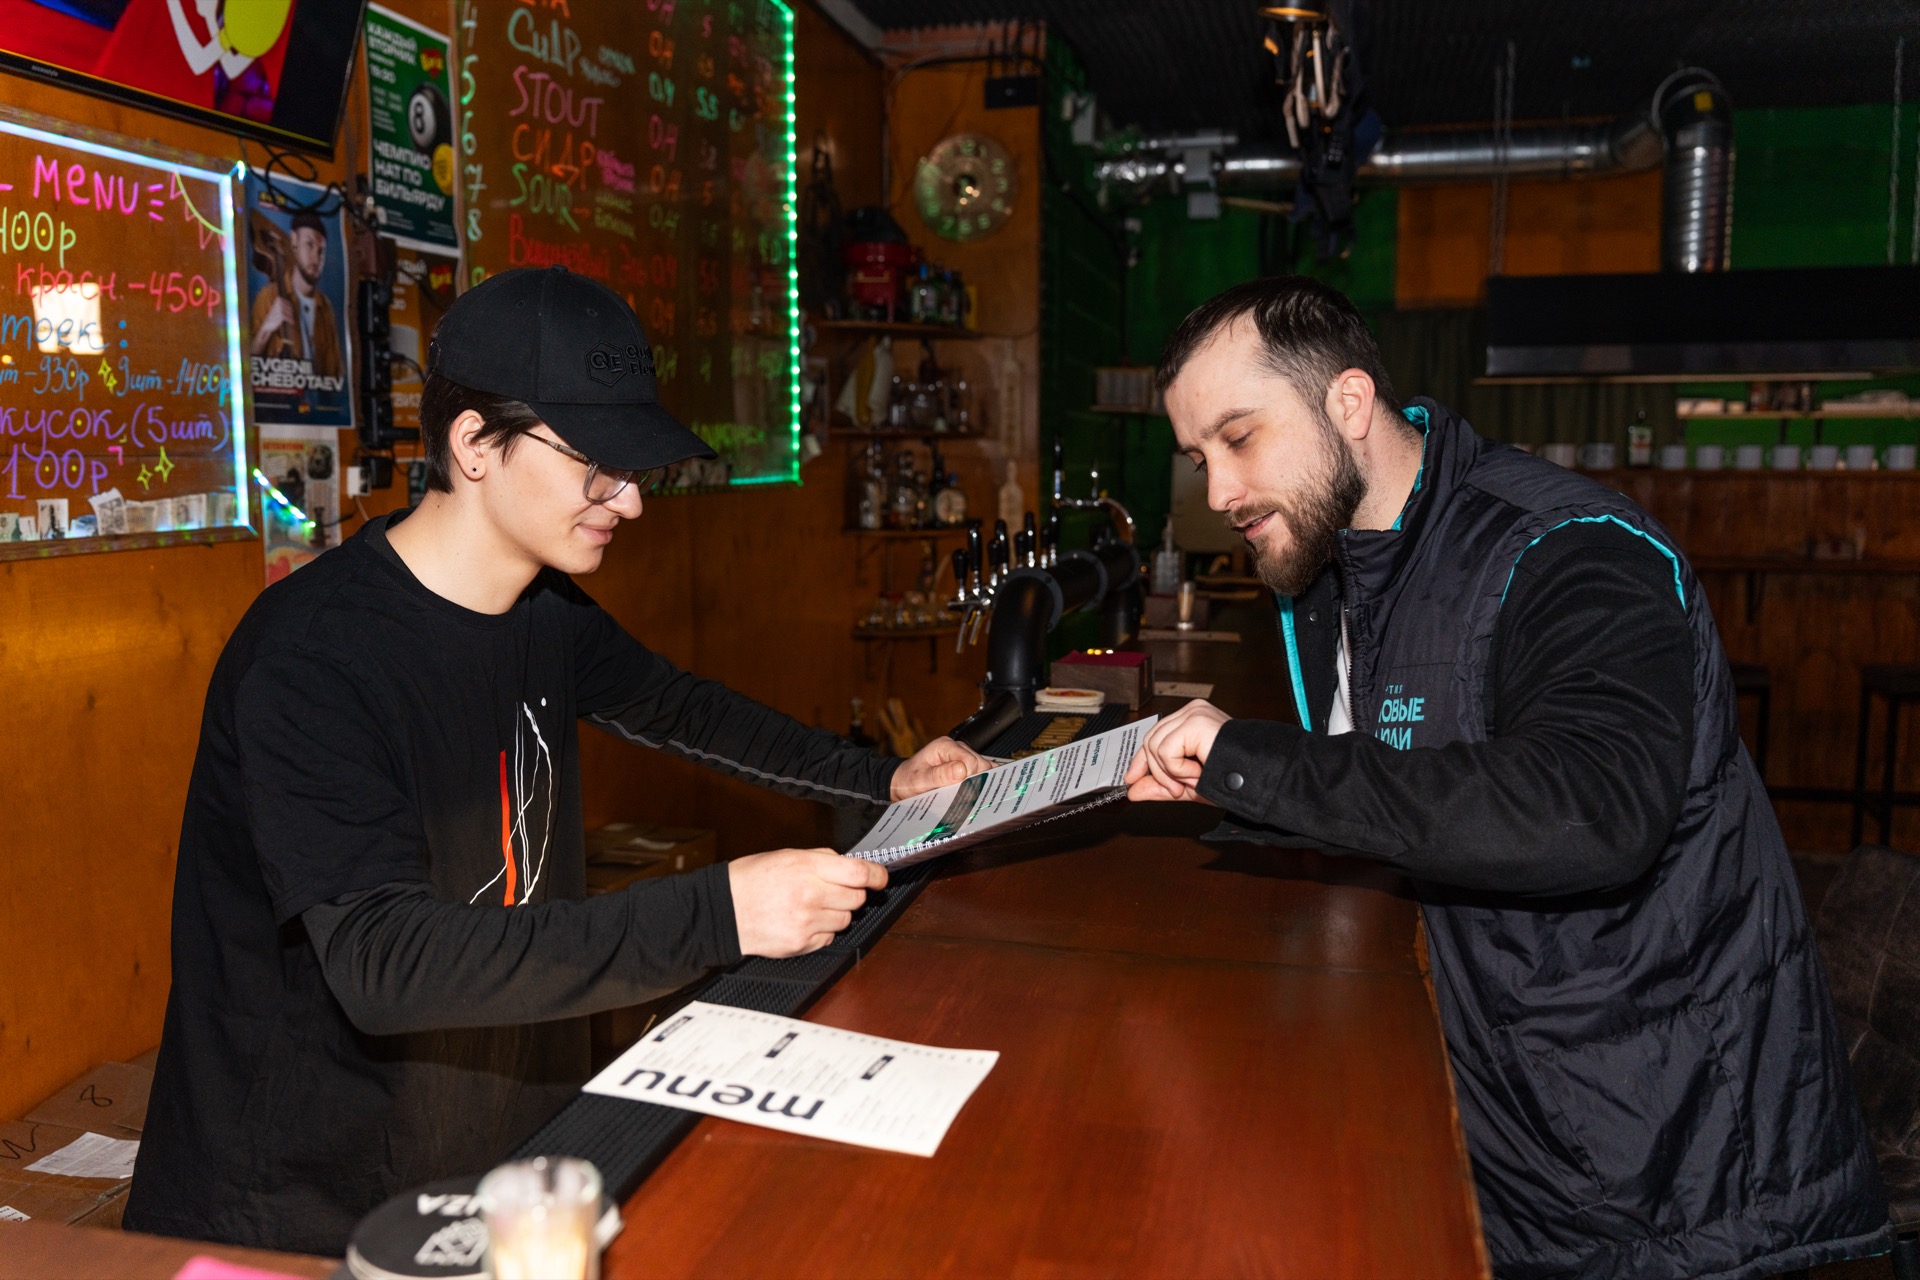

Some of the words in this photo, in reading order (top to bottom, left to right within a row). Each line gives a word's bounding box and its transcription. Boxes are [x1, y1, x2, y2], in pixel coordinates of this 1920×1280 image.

[461, 54, 478, 105] 5
[508, 64, 605, 138] STOUT
[461, 110, 477, 156] 6
[402, 167, 423, 187] ПО
[463, 163, 487, 204] 7
[510, 163, 581, 233] SOUR
[466, 208, 483, 242] 8
[251, 355, 314, 376] EVGENII
[251, 371, 345, 392] CHEBOTAEV
[590, 351, 623, 373] QE
[618, 1067, 825, 1120] menu
